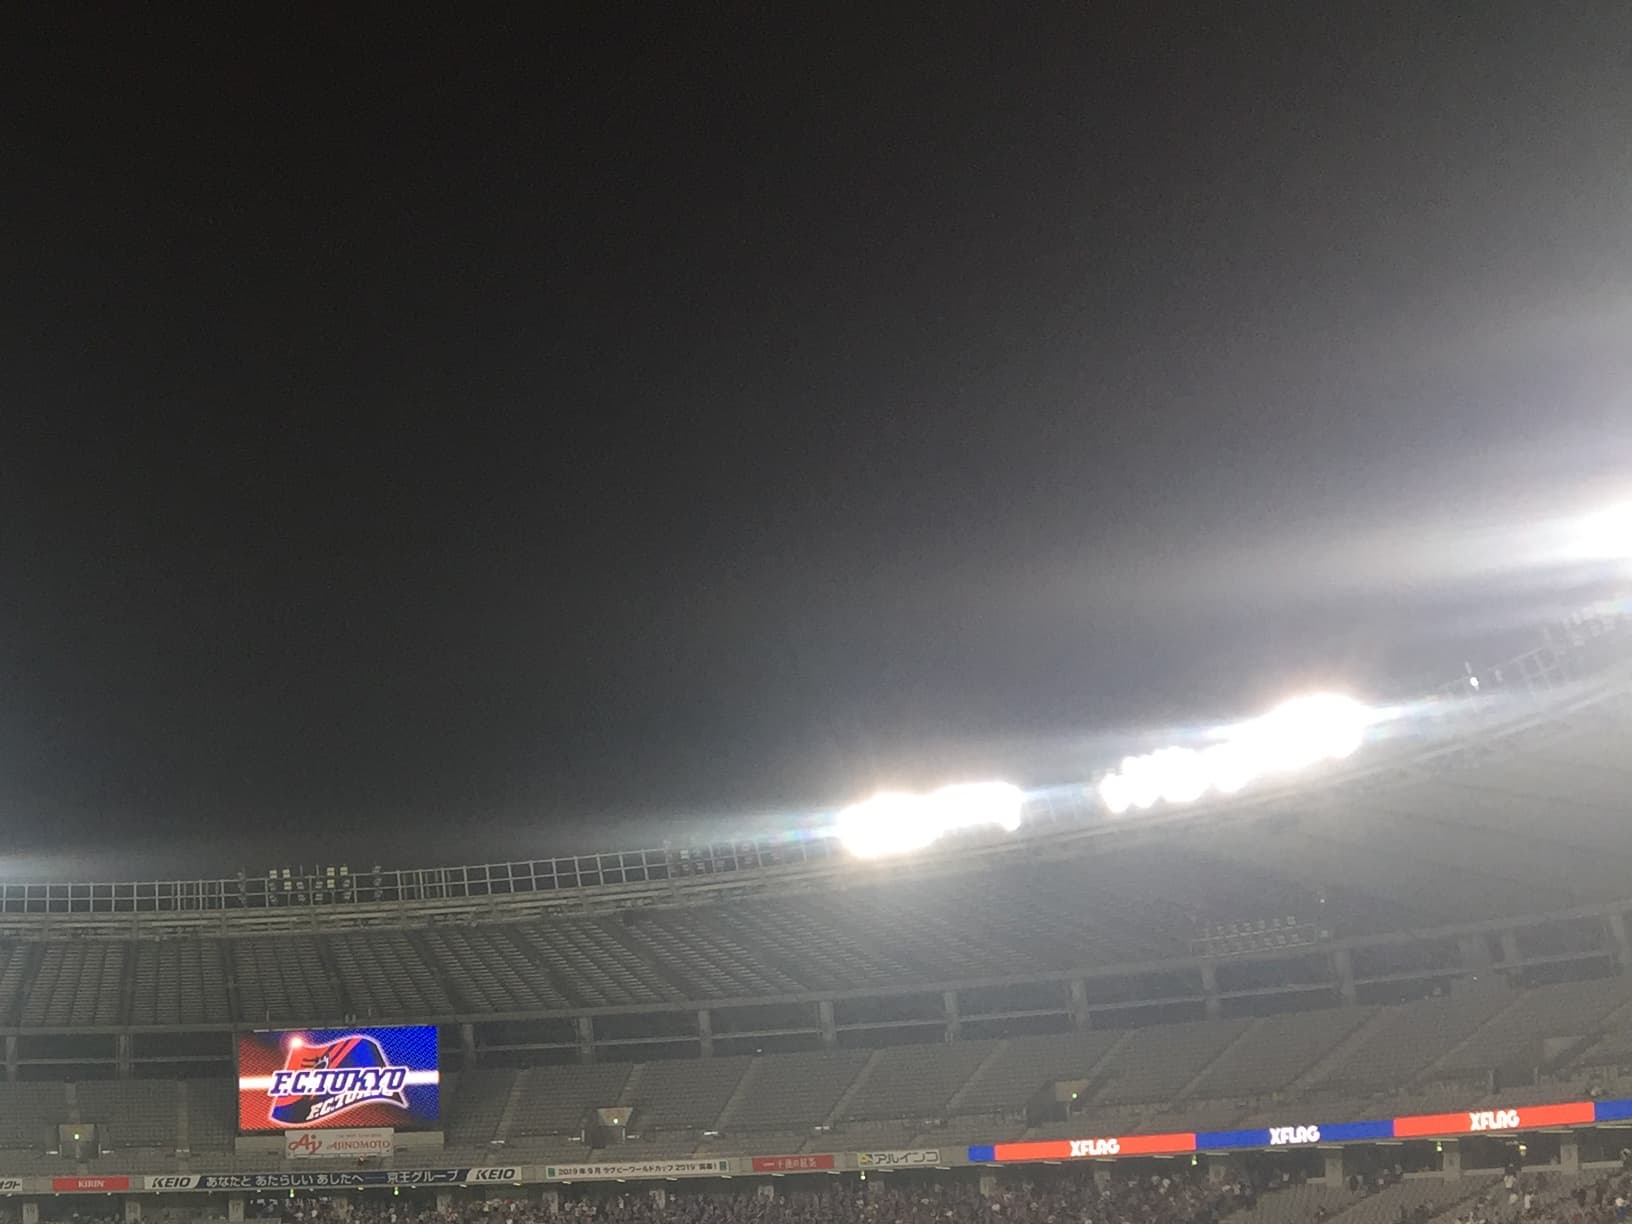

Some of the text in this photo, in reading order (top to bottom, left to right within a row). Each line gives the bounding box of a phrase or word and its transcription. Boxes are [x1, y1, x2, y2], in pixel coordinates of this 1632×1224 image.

[1470, 1109, 1520, 1131] XFLAG
[1270, 1125, 1321, 1146] XFLAG
[327, 1140, 390, 1151] AJINOMOTO
[1069, 1138, 1121, 1157] XFLAG
[206, 1173, 364, 1188] あなたと あたらしい あしたへ
[386, 1170, 459, 1184] 京王グループ
[475, 1168, 516, 1180] KEIO
[77, 1180, 104, 1189] KIRIN
[152, 1177, 191, 1188] KEIO
